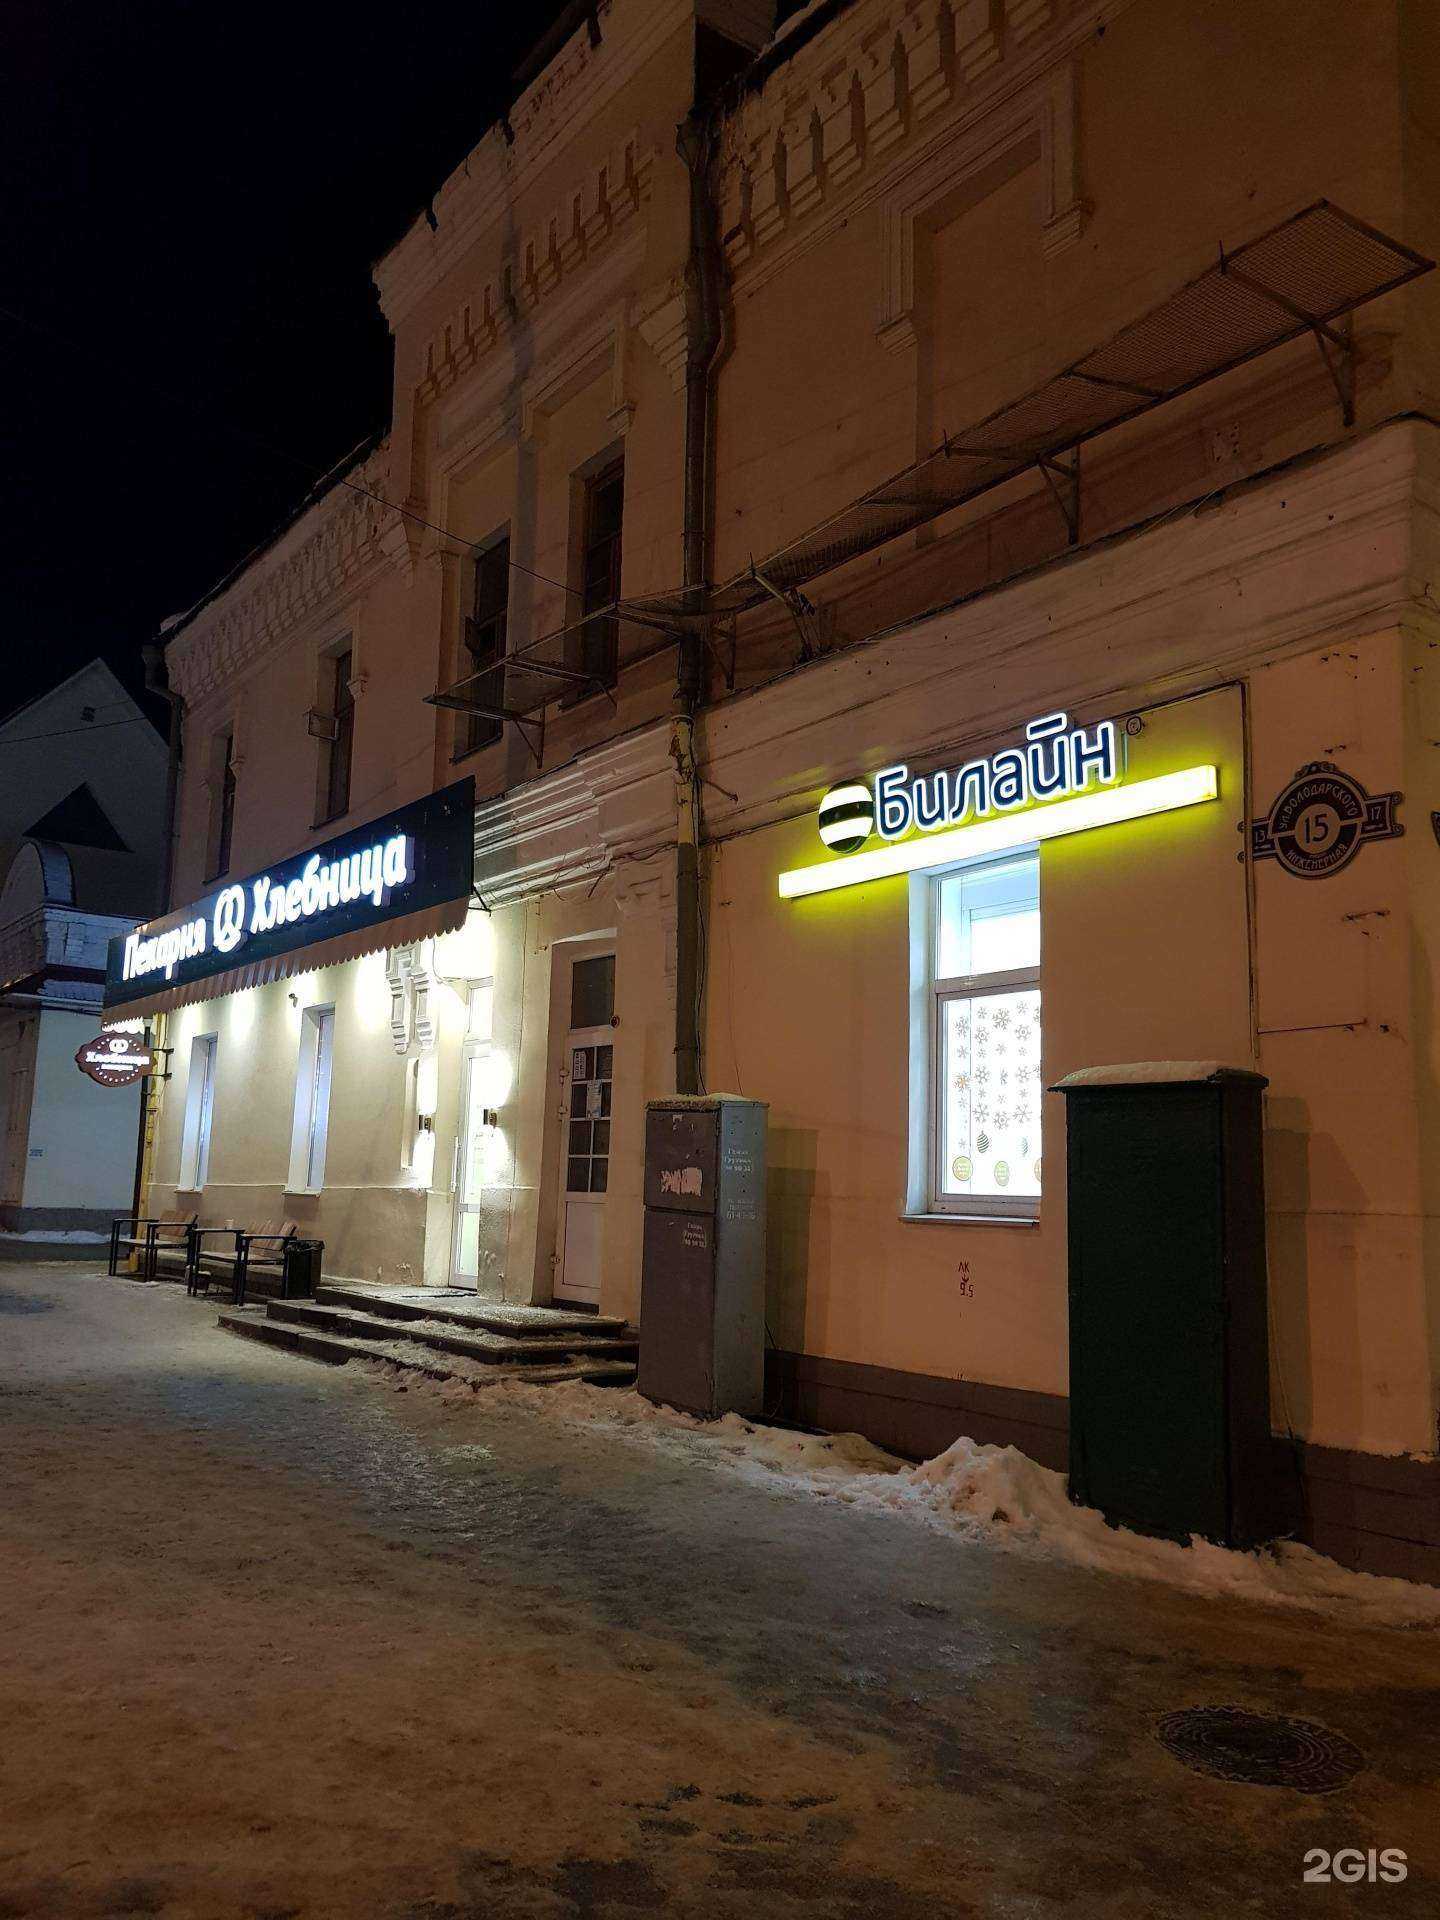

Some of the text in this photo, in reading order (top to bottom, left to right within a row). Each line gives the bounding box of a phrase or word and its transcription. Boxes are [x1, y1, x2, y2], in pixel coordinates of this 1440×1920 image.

[1371, 805, 1381, 820] 17
[1304, 813, 1329, 844] 15
[122, 834, 407, 980] Пекарня Хлебница
